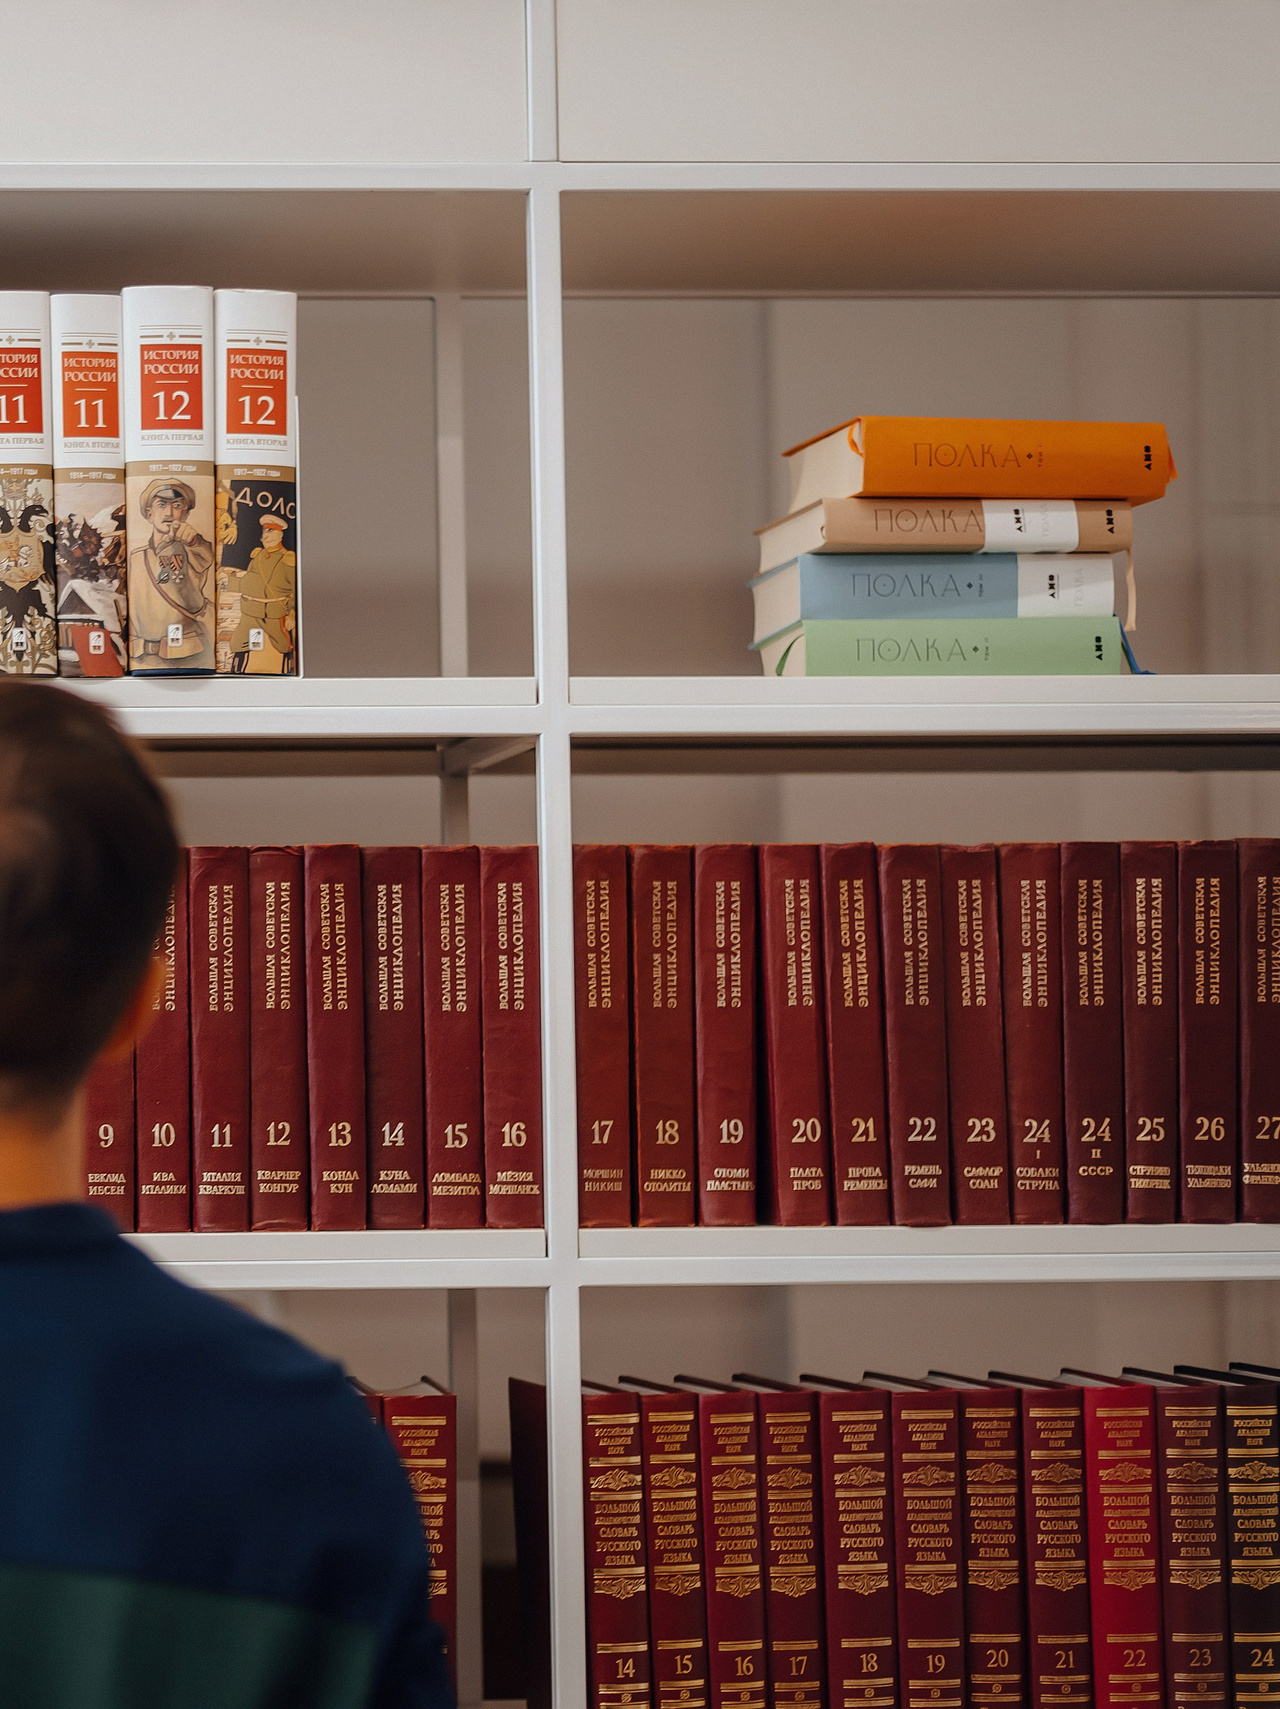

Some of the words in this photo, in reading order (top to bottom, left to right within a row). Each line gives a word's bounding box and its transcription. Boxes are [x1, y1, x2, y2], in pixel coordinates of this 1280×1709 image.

[63, 358, 117, 370] ИСТОРИЯ
[144, 350, 200, 362] ИСТОРИЯ
[230, 354, 284, 367] ИСТОРИЯ
[64, 371, 117, 383] РОССИИ
[144, 363, 200, 375] РОССИИ
[230, 368, 284, 380] РОССИИ
[74, 398, 107, 429] 11
[152, 390, 192, 421] 12
[238, 395, 277, 426] 12
[64, 441, 90, 449] КНИГА
[91, 440, 120, 449] ВТОРАЯ
[913, 443, 1021, 468] ПОЛКА
[873, 508, 983, 533] ПОЛКА
[852, 573, 961, 597] ПОЛКА
[856, 638, 967, 662] ПОЛКА
[266, 882, 275, 949] СОВЕТСКАЯ
[958, 879, 969, 946] СОВЕТСКАЯ
[280, 882, 291, 1010] ЭНЦИКЛОПЕДИЯ
[972, 879, 986, 1007] ЭНЦИКЛОПЕДИЯ
[266, 1121, 291, 1146] 12
[501, 1122, 527, 1147] 16
[967, 1117, 996, 1143] 23
[1080, 1117, 1112, 1142] 24
[257, 1170, 301, 1181] КВАРНЕР
[964, 1167, 1004, 1177] САФЛОР
[1078, 1166, 1114, 1176] СССР
[259, 1183, 300, 1193] КОНГУР
[970, 1179, 999, 1189] СОАН
[839, 1498, 883, 1511] БОЛЬШОЙ
[843, 1524, 881, 1534] СЛОВАРЬ
[840, 1537, 884, 1548] РУССКОГО
[848, 1551, 878, 1561] ЯЗЫКА
[860, 1652, 879, 1673] 18
[1123, 1649, 1147, 1668] 22
[1250, 1649, 1275, 1667] 24
